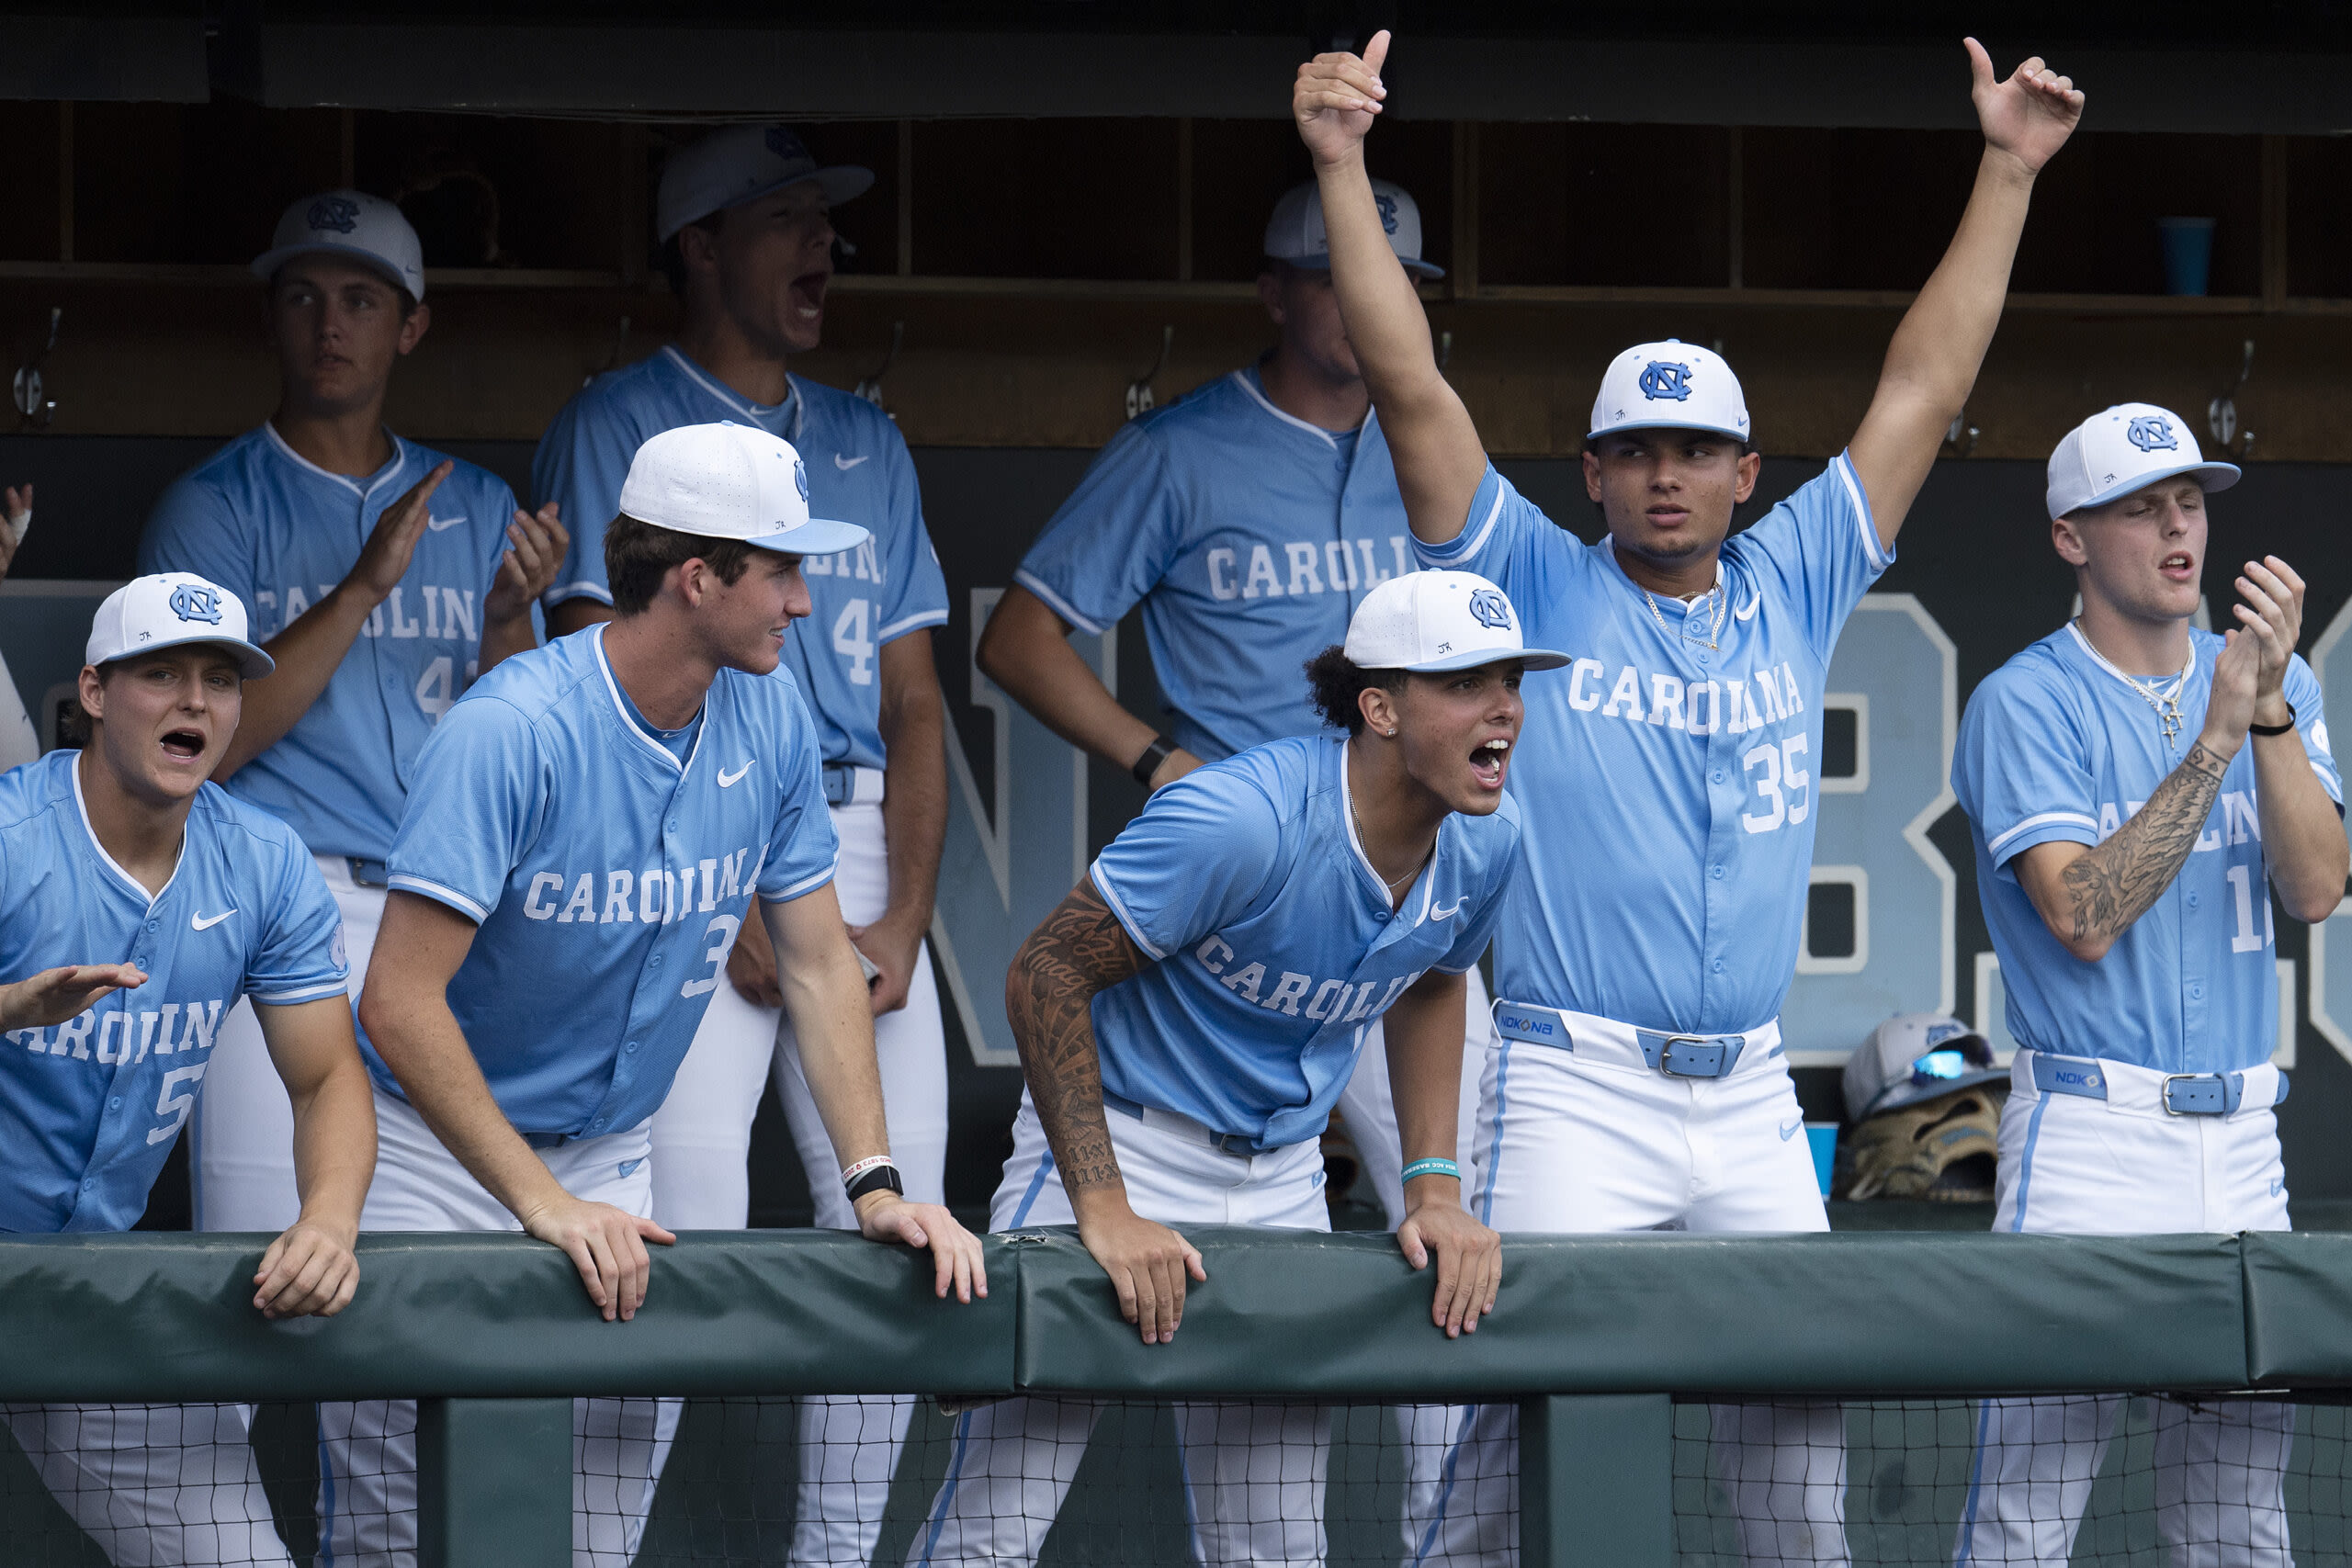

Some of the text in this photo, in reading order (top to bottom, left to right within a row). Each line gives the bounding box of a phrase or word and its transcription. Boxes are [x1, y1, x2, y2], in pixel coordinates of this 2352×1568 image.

[1206, 536, 1419, 600] CAROLI
[1568, 658, 1804, 735] CAROLINA
[1743, 732, 1810, 834] 35
[681, 914, 741, 998] 3
[146, 1061, 208, 1145] 5
